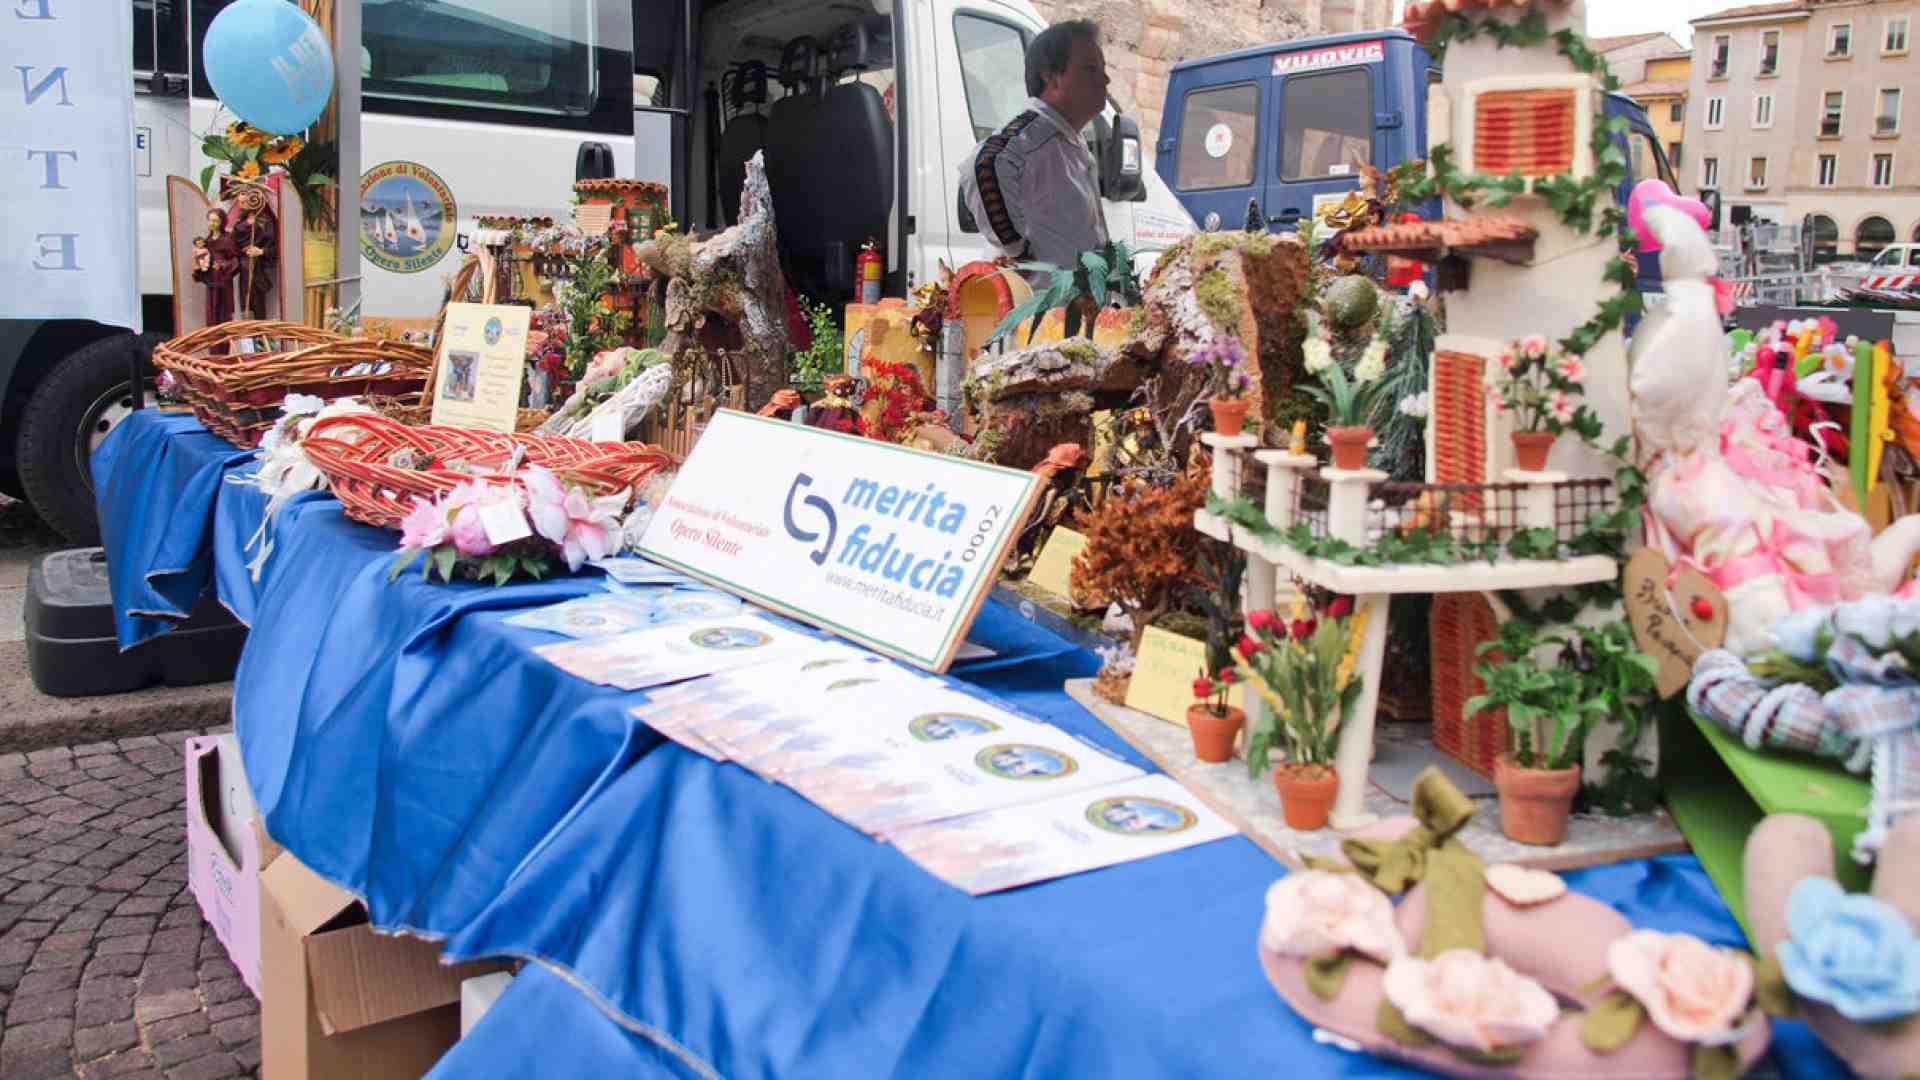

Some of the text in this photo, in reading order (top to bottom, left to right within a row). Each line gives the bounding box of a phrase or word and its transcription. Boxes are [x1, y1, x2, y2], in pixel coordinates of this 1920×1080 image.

[841, 477, 967, 535] merita
[961, 504, 1003, 563] 0002
[704, 529, 743, 556] Silente
[836, 523, 965, 598] fiducia
[825, 571, 946, 622] www.meritafiducia.it
